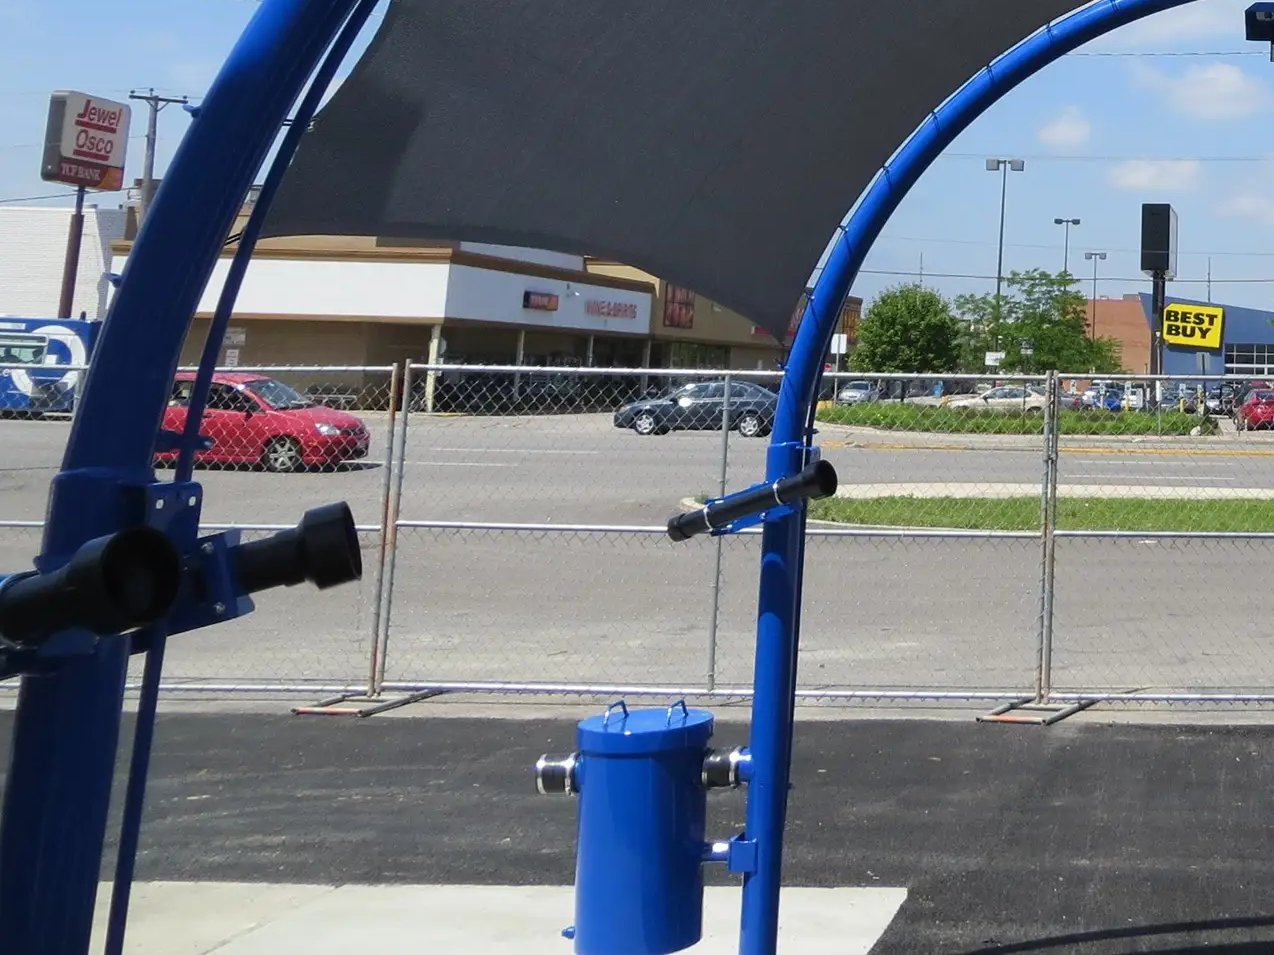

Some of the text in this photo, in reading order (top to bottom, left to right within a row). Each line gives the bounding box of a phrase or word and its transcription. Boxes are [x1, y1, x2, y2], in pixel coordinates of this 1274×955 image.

[77, 99, 123, 127] Jewel
[76, 129, 114, 155] Osco
[60, 163, 101, 180] TCF BANK
[1165, 309, 1218, 327] BEST
[1166, 323, 1212, 340] BUY
